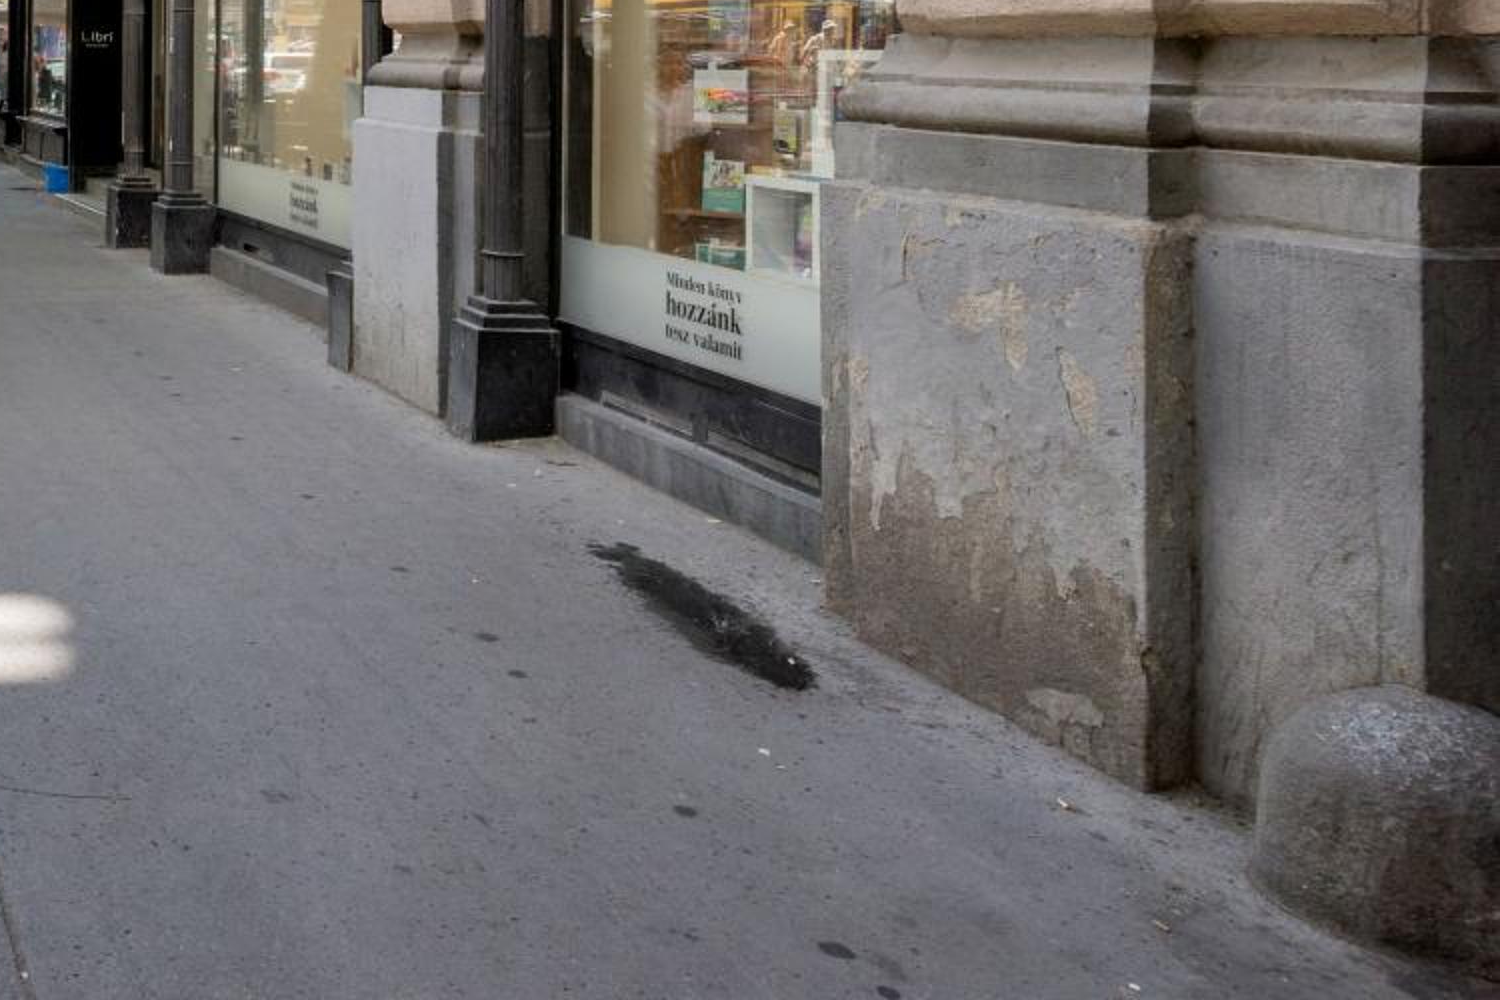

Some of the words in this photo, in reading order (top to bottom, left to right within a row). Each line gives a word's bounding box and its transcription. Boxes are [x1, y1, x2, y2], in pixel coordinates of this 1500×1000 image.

[666, 271, 706, 295] Minden
[707, 281, 741, 305] könyv
[665, 289, 741, 335] hozzánk
[665, 322, 690, 344] tesz
[693, 333, 743, 360] valamit
